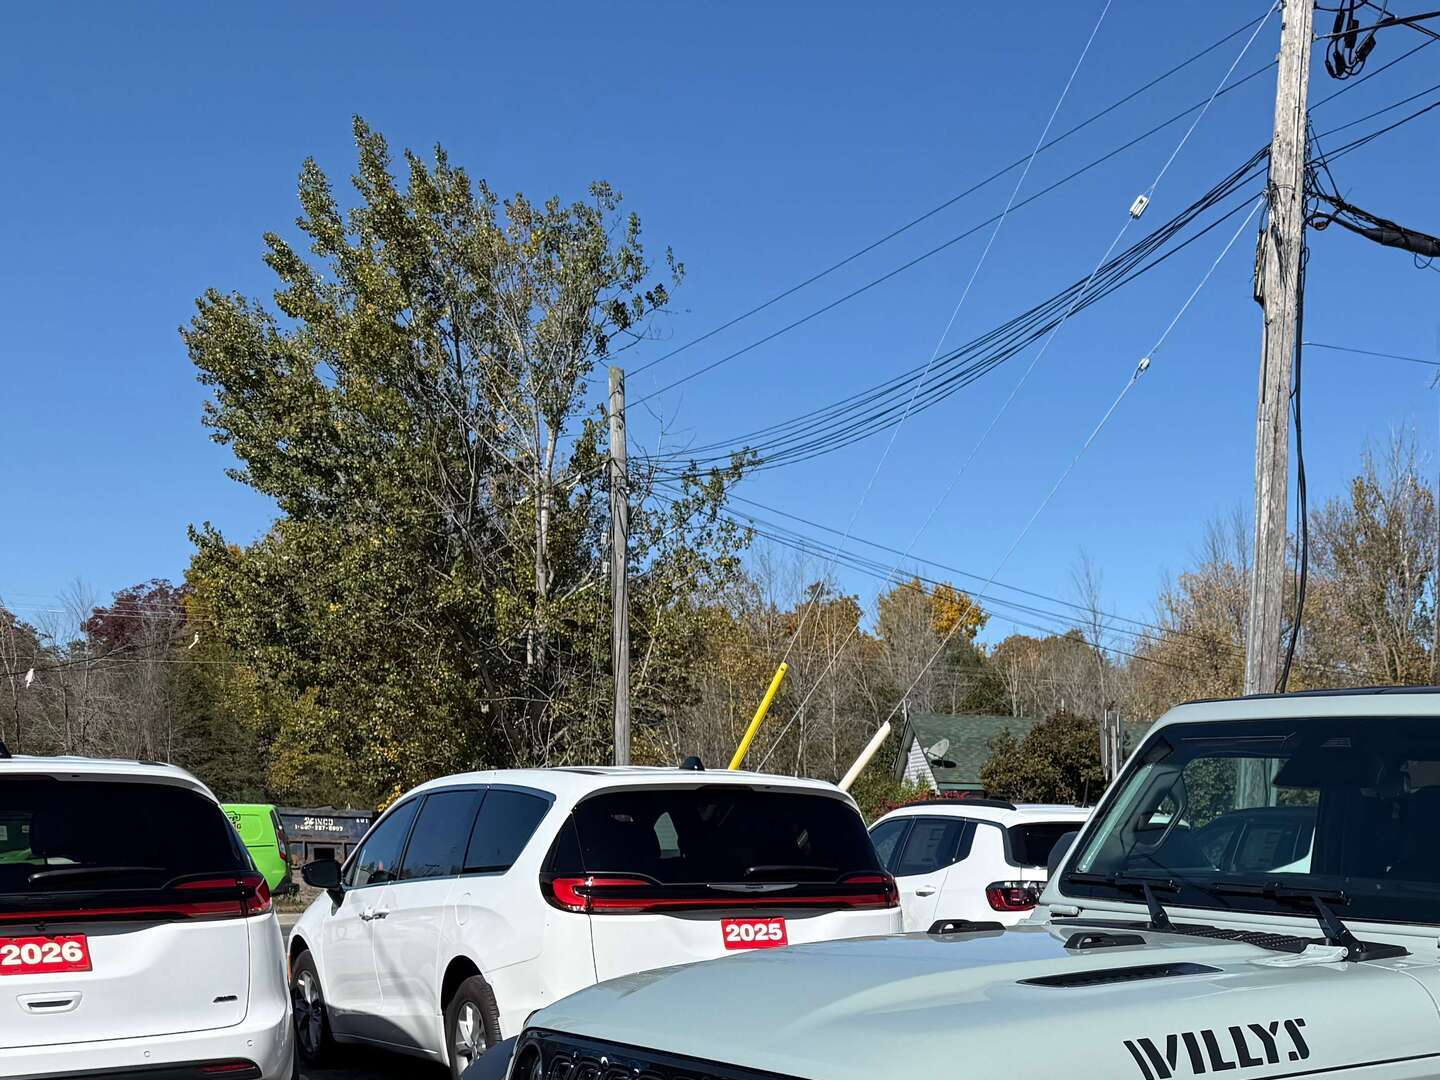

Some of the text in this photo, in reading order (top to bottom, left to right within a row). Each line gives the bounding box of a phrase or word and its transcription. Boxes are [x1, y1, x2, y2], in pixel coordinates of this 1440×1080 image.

[725, 922, 784, 942] 2025
[0, 940, 83, 966] 2026
[1122, 1017, 1310, 1080] WILLYS
